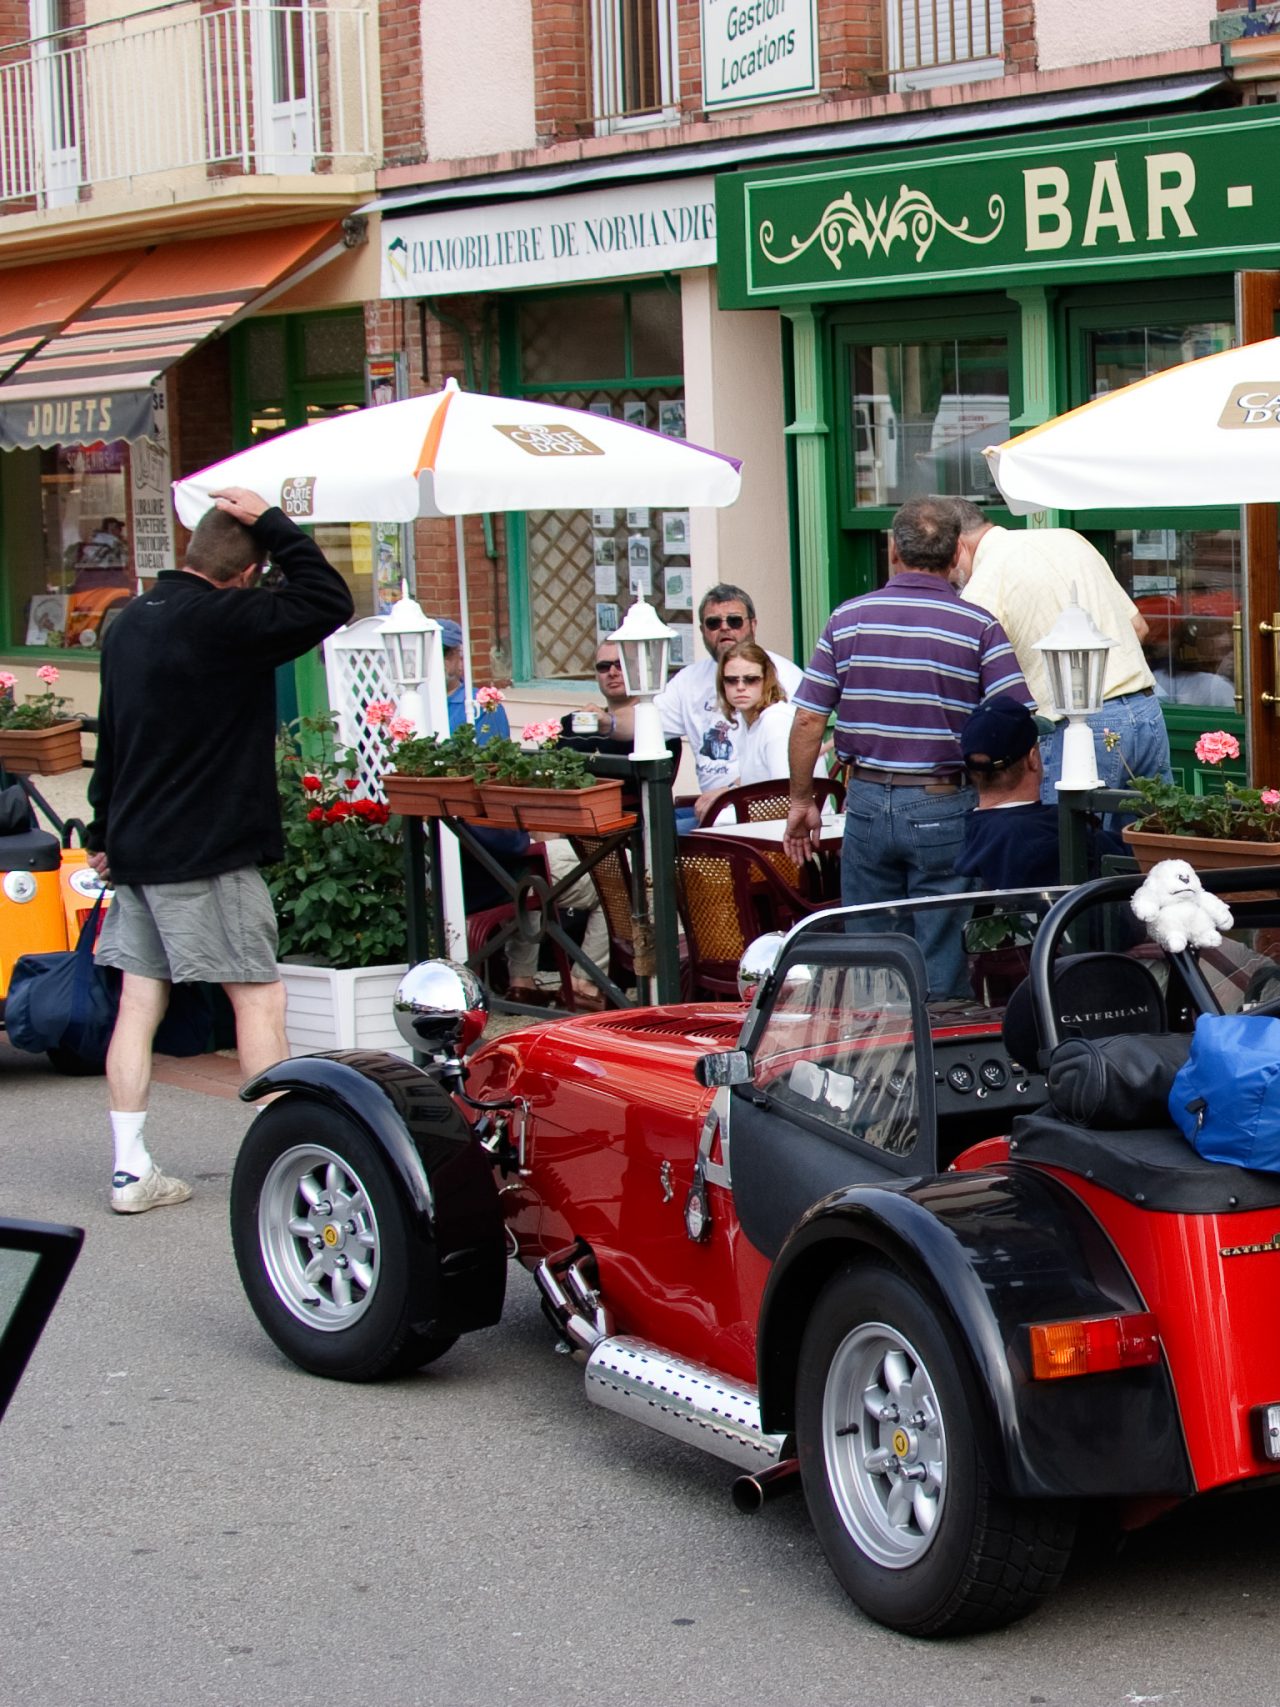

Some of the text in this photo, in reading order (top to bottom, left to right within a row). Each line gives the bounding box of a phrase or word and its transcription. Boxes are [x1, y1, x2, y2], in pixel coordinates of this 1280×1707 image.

[727, 0, 785, 41] Gestion
[721, 28, 796, 90] Locations
[1022, 151, 1198, 253] BAR
[411, 202, 717, 275] IMMOBILIERE DE NORMANDIE
[27, 397, 112, 437] JOUETS
[510, 431, 584, 446] CARTE
[530, 441, 594, 454] D'OR
[282, 485, 312, 500] CARTE
[286, 499, 310, 514] D'OR
[1060, 1004, 1149, 1023] CATERHAM
